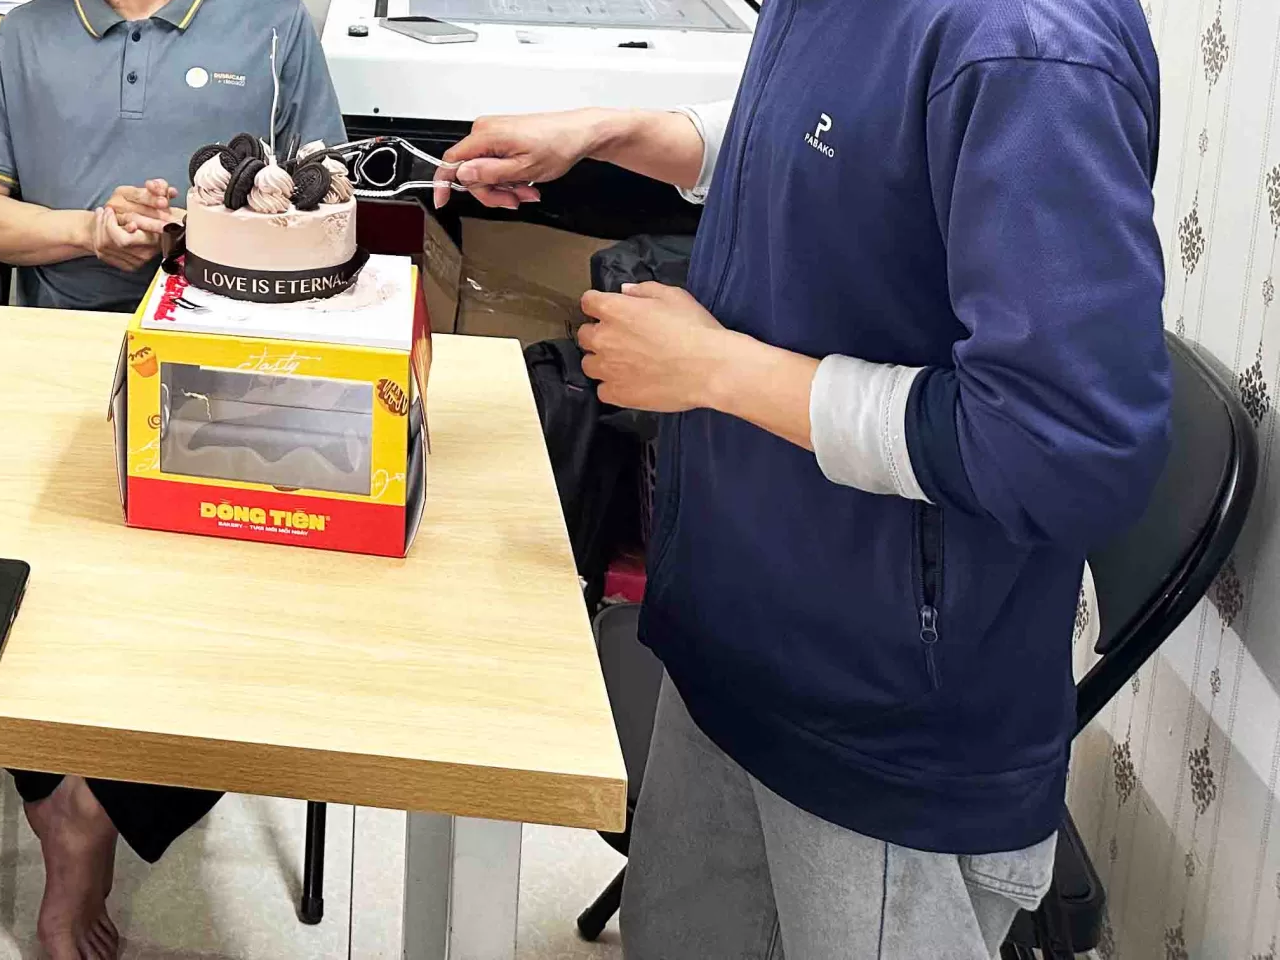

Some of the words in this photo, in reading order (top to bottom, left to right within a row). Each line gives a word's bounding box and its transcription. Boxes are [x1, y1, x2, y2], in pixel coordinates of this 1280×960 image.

[804, 132, 834, 158] PABAKO
[204, 268, 247, 292] LOVE
[252, 279, 270, 294] IS
